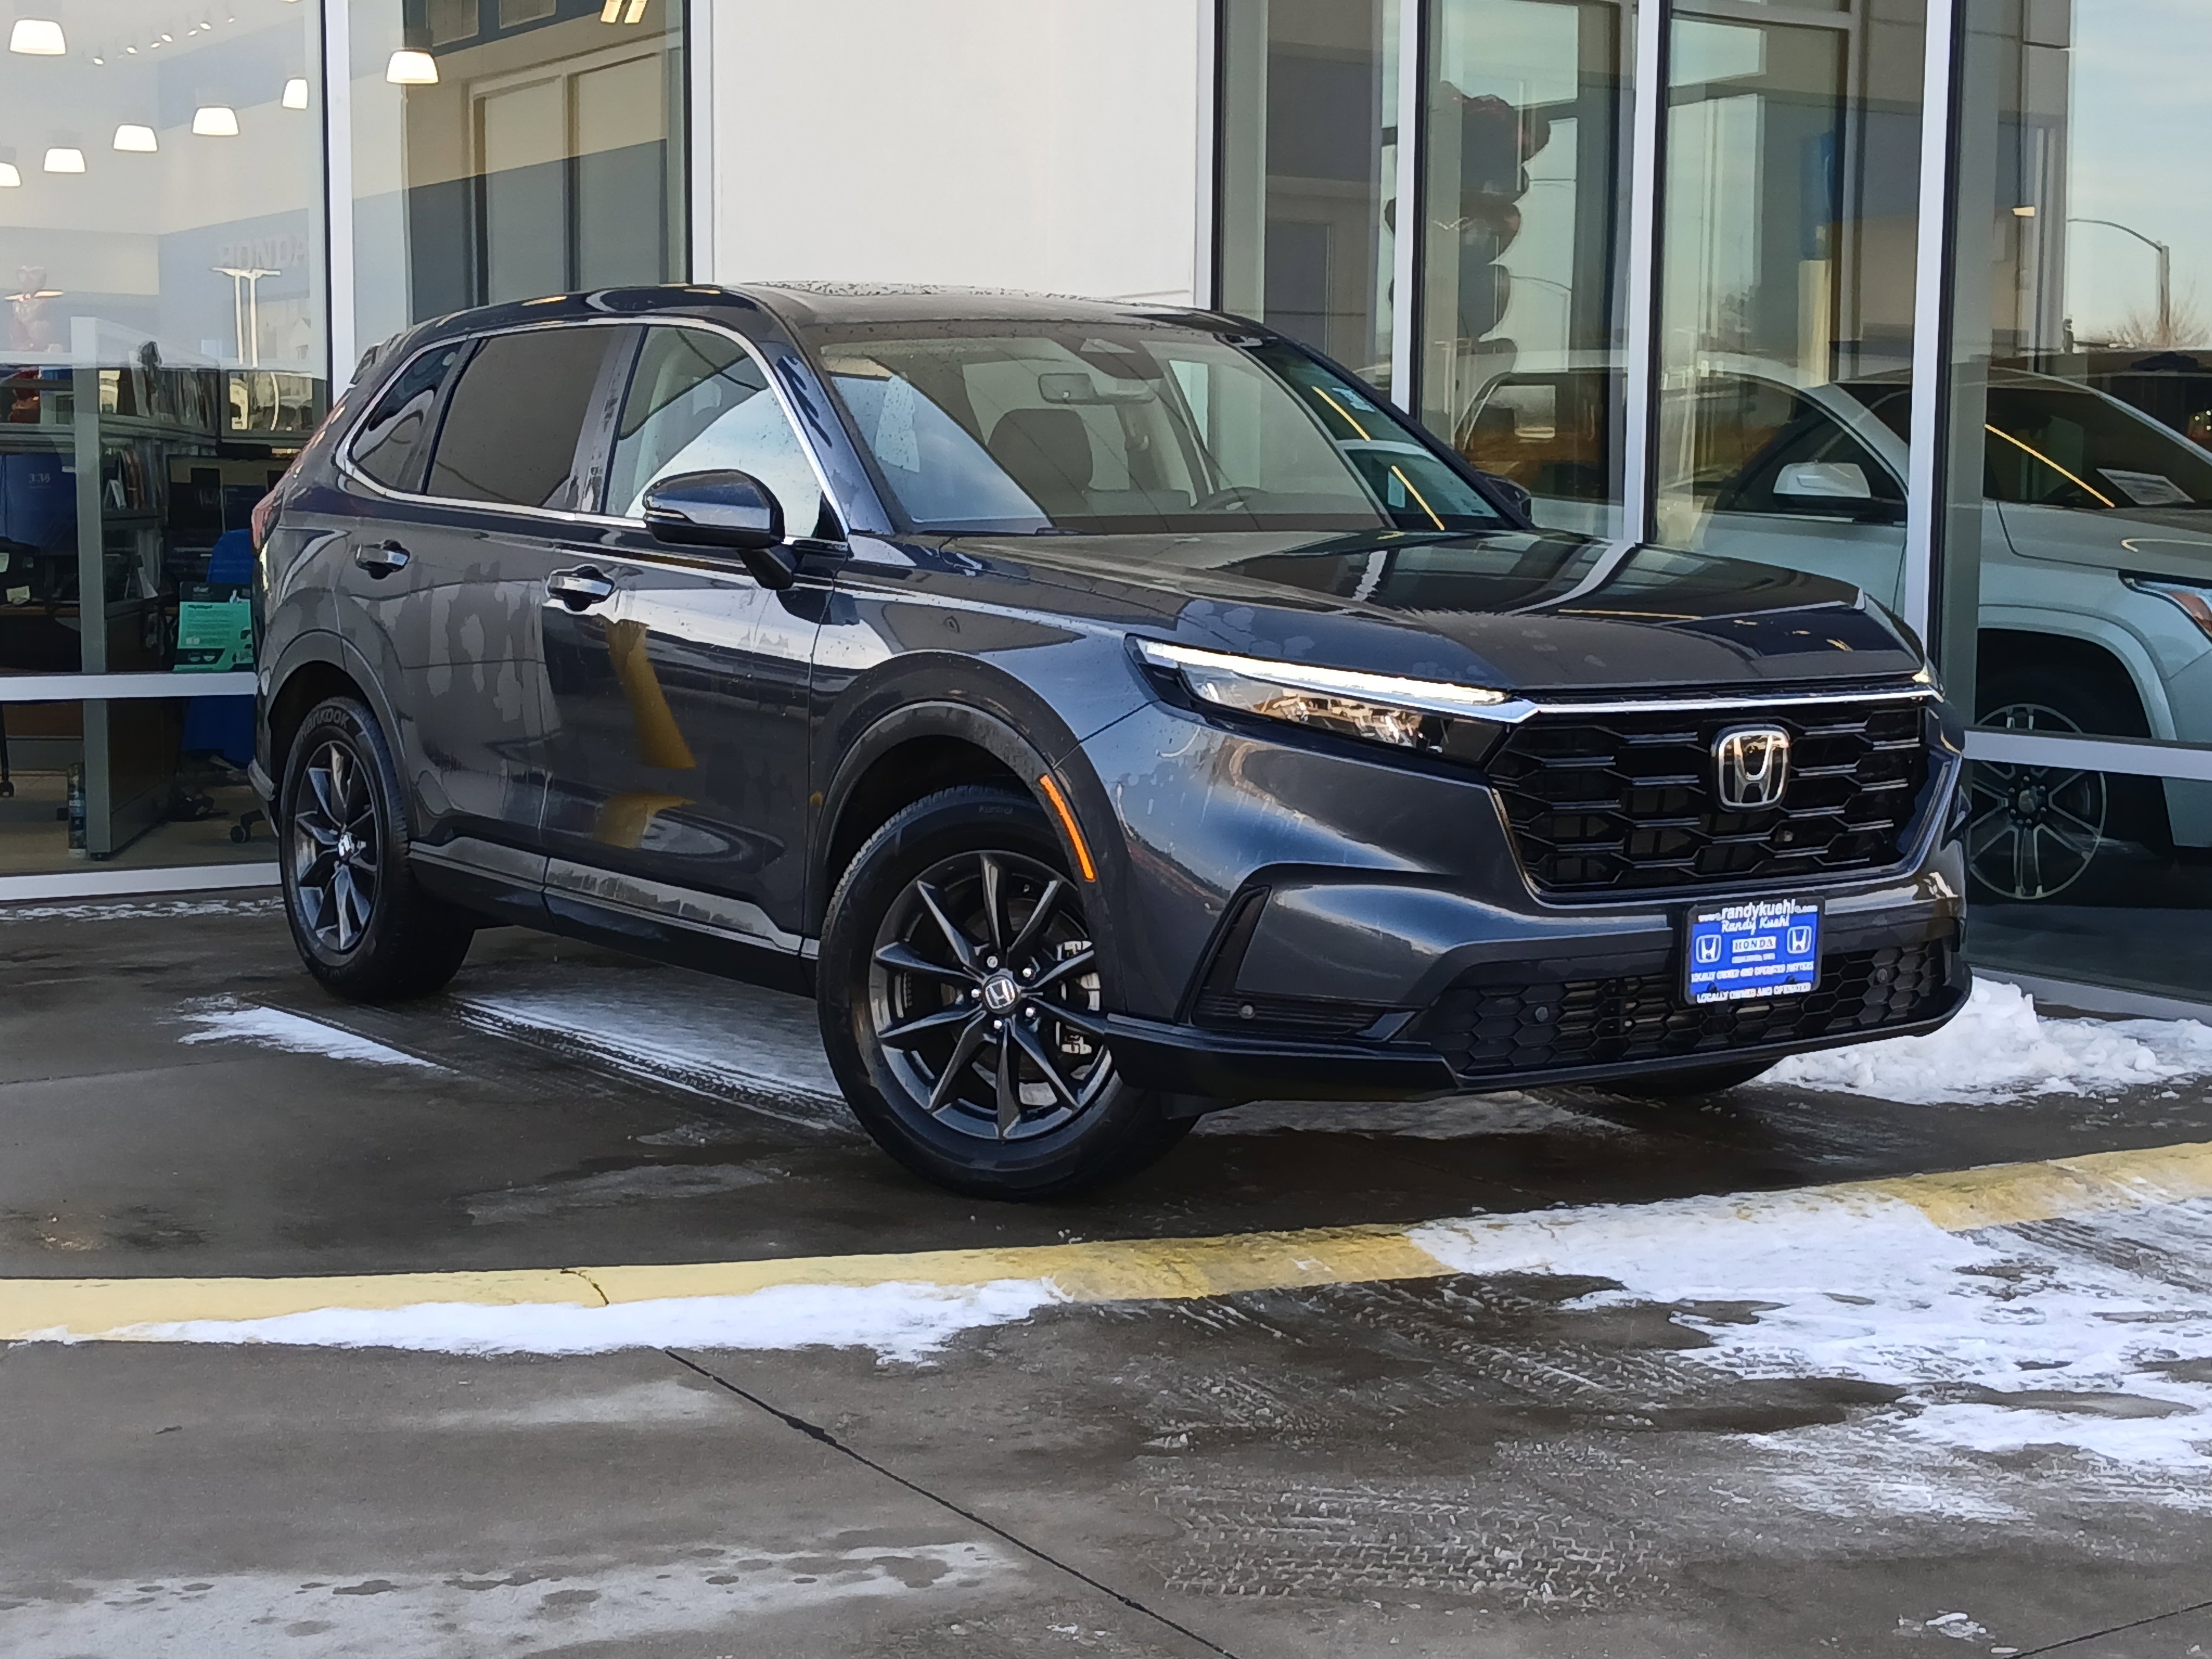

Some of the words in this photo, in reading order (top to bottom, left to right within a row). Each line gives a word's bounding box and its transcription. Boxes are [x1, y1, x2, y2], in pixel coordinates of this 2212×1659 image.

[1721, 918, 1756, 936] Randy
[1734, 938, 1773, 950] HONDA
[1696, 991, 1728, 1003] LOCALLY
